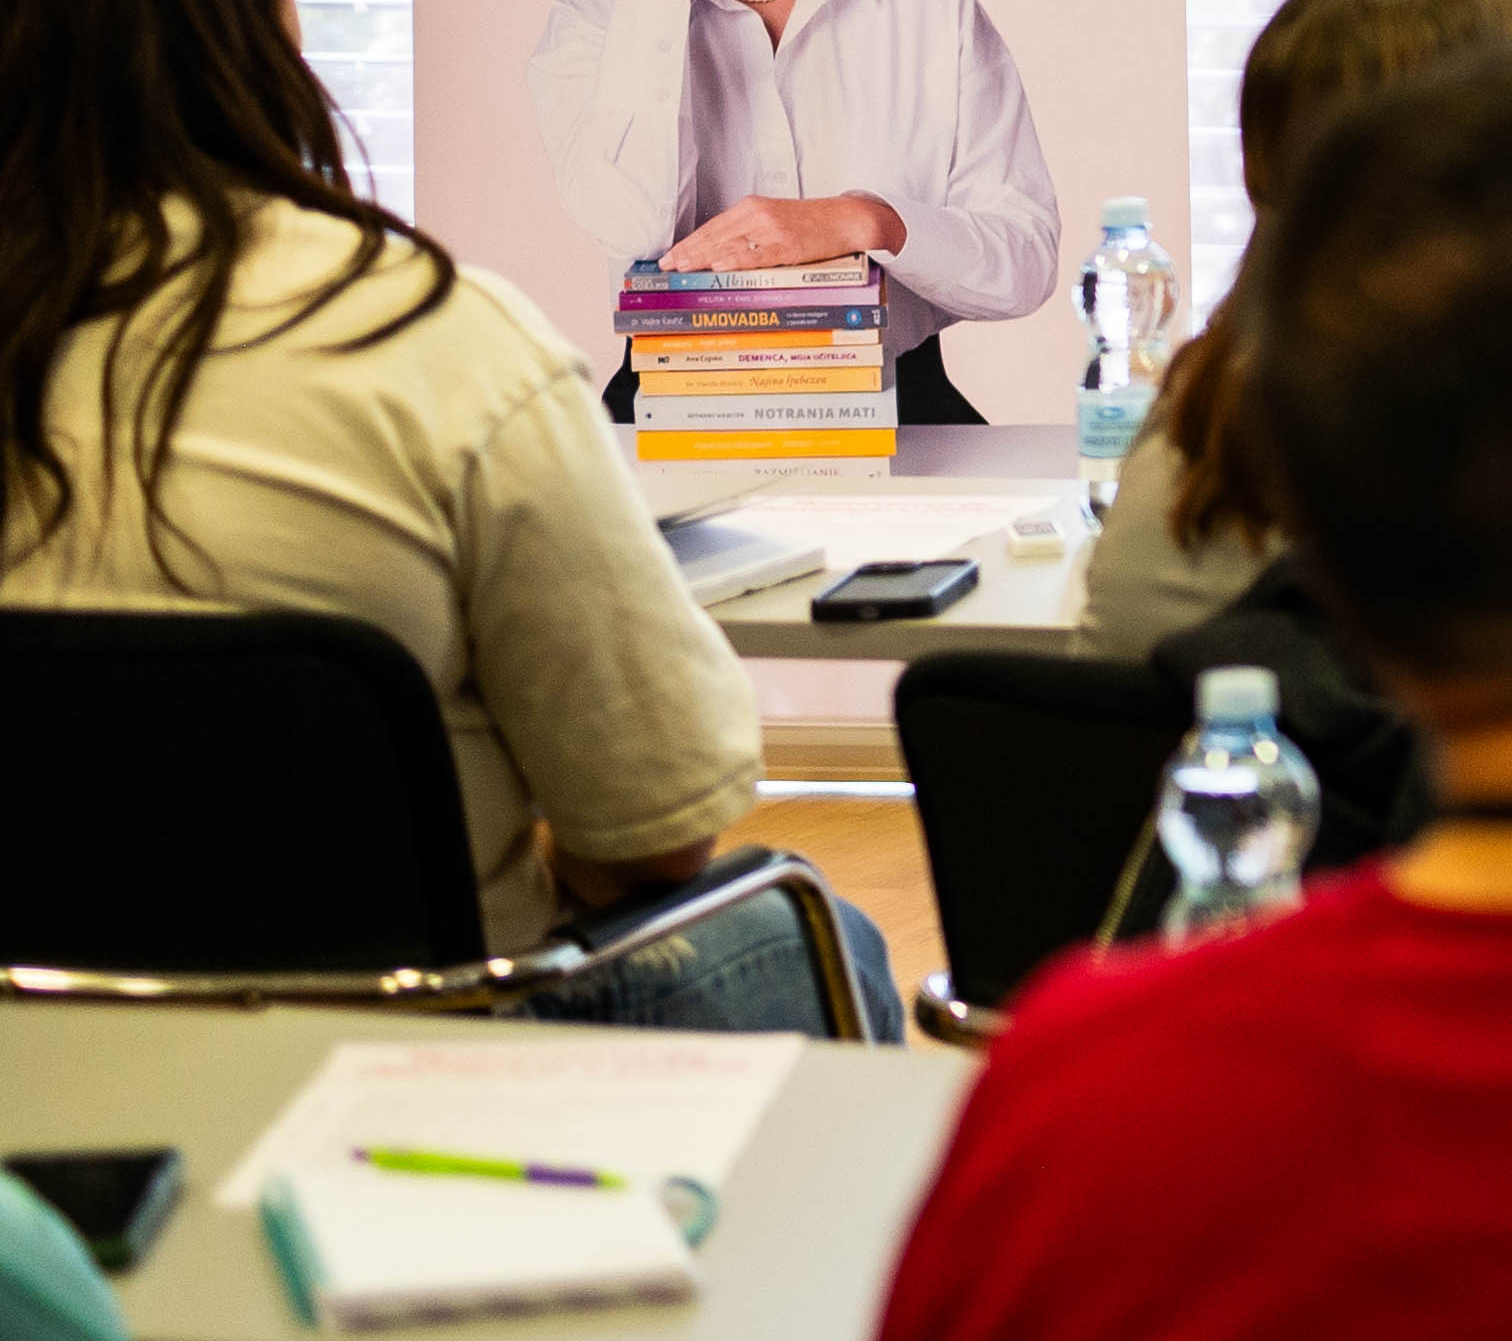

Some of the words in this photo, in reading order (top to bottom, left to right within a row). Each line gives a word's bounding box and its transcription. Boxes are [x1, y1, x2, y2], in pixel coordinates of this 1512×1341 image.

[692, 311, 780, 328] UMOVADBA
[754, 408, 834, 420] NOTRANJA
[837, 406, 876, 419] MATI
